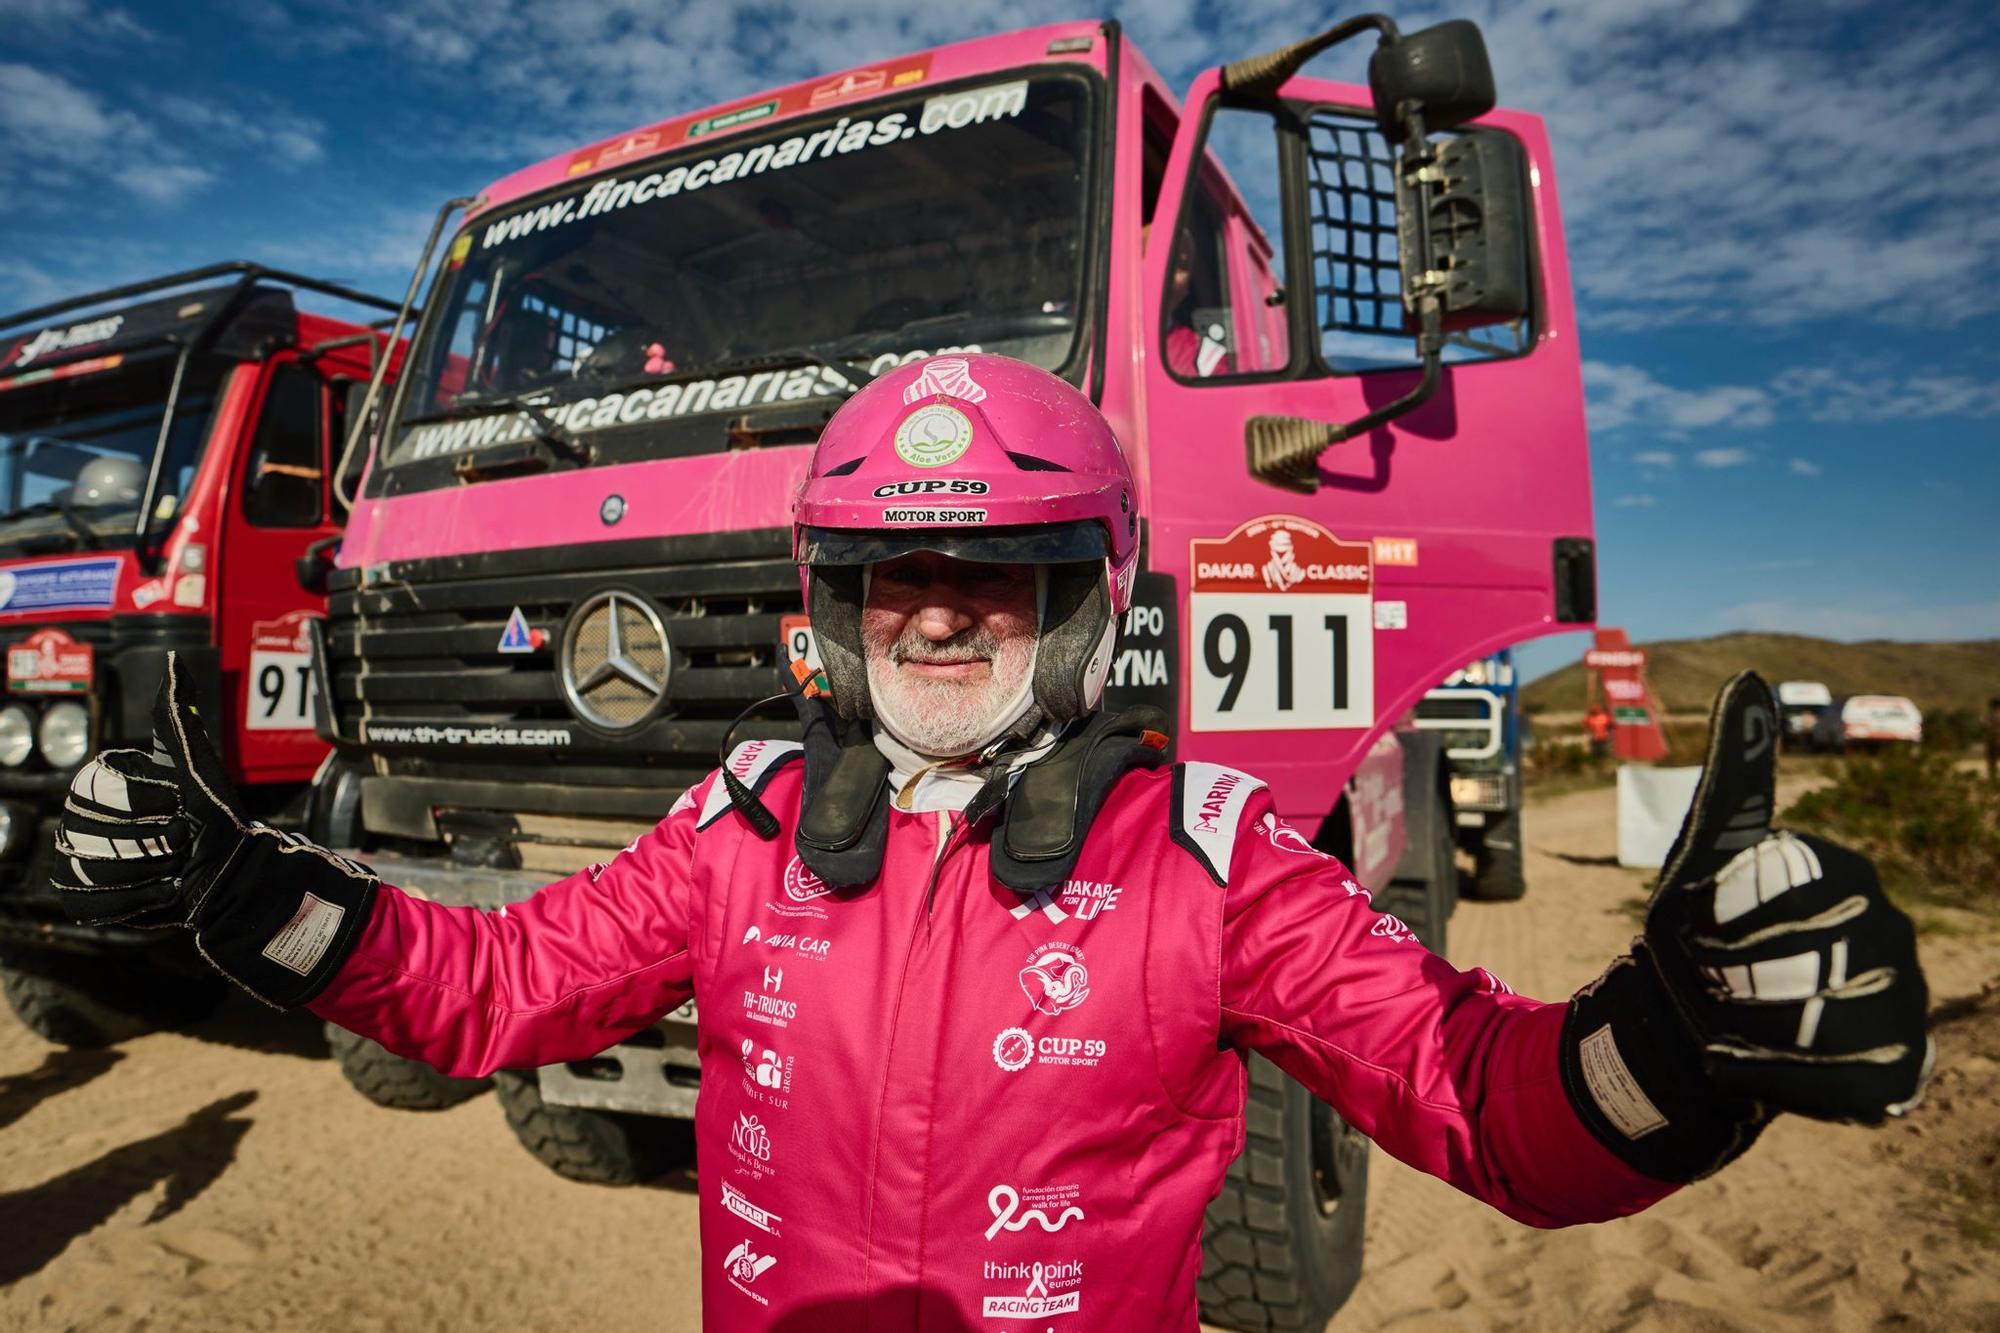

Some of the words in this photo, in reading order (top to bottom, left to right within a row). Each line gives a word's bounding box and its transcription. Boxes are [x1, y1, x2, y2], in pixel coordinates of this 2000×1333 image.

[482, 79, 1028, 249] www.fincacanarias.com
[908, 451, 933, 464] Aloe
[934, 448, 959, 463] Vera
[873, 480, 947, 499] CUP
[950, 480, 988, 494] 59
[884, 510, 937, 522] MOTOR
[939, 510, 986, 522] SPORT
[1198, 562, 1256, 579] DAKAR
[1306, 564, 1369, 581] CLASSIC
[1106, 649, 1169, 688] YNA
[1203, 613, 1350, 713] 911
[367, 726, 571, 746] www.th-trucks.com
[1194, 773, 1244, 834] MARINA
[1062, 880, 1113, 898] DAKAR
[1063, 897, 1080, 905] FOR
[764, 934, 797, 949] AVIA
[799, 937, 831, 955] CAR
[743, 990, 798, 1019] TH-TRUCKS
[1038, 1036, 1082, 1056] CUP
[1083, 1039, 1107, 1057] 59
[1038, 1055, 1070, 1065] MOTOR
[1071, 1057, 1099, 1067] SPORT
[768, 1095, 789, 1111] SUR
[1022, 1193, 1046, 1201] carrera
[1046, 1193, 1060, 1203] por
[1066, 1191, 1080, 1199] vida
[1031, 1201, 1049, 1209] walk
[1049, 1200, 1060, 1208] for
[720, 1184, 782, 1233] XIMART
[984, 1261, 1031, 1280] think
[1044, 1260, 1083, 1284] pink
[1049, 1277, 1082, 1289] europe
[988, 1299, 1040, 1313] RACING
[1041, 1297, 1075, 1312] TEAM
